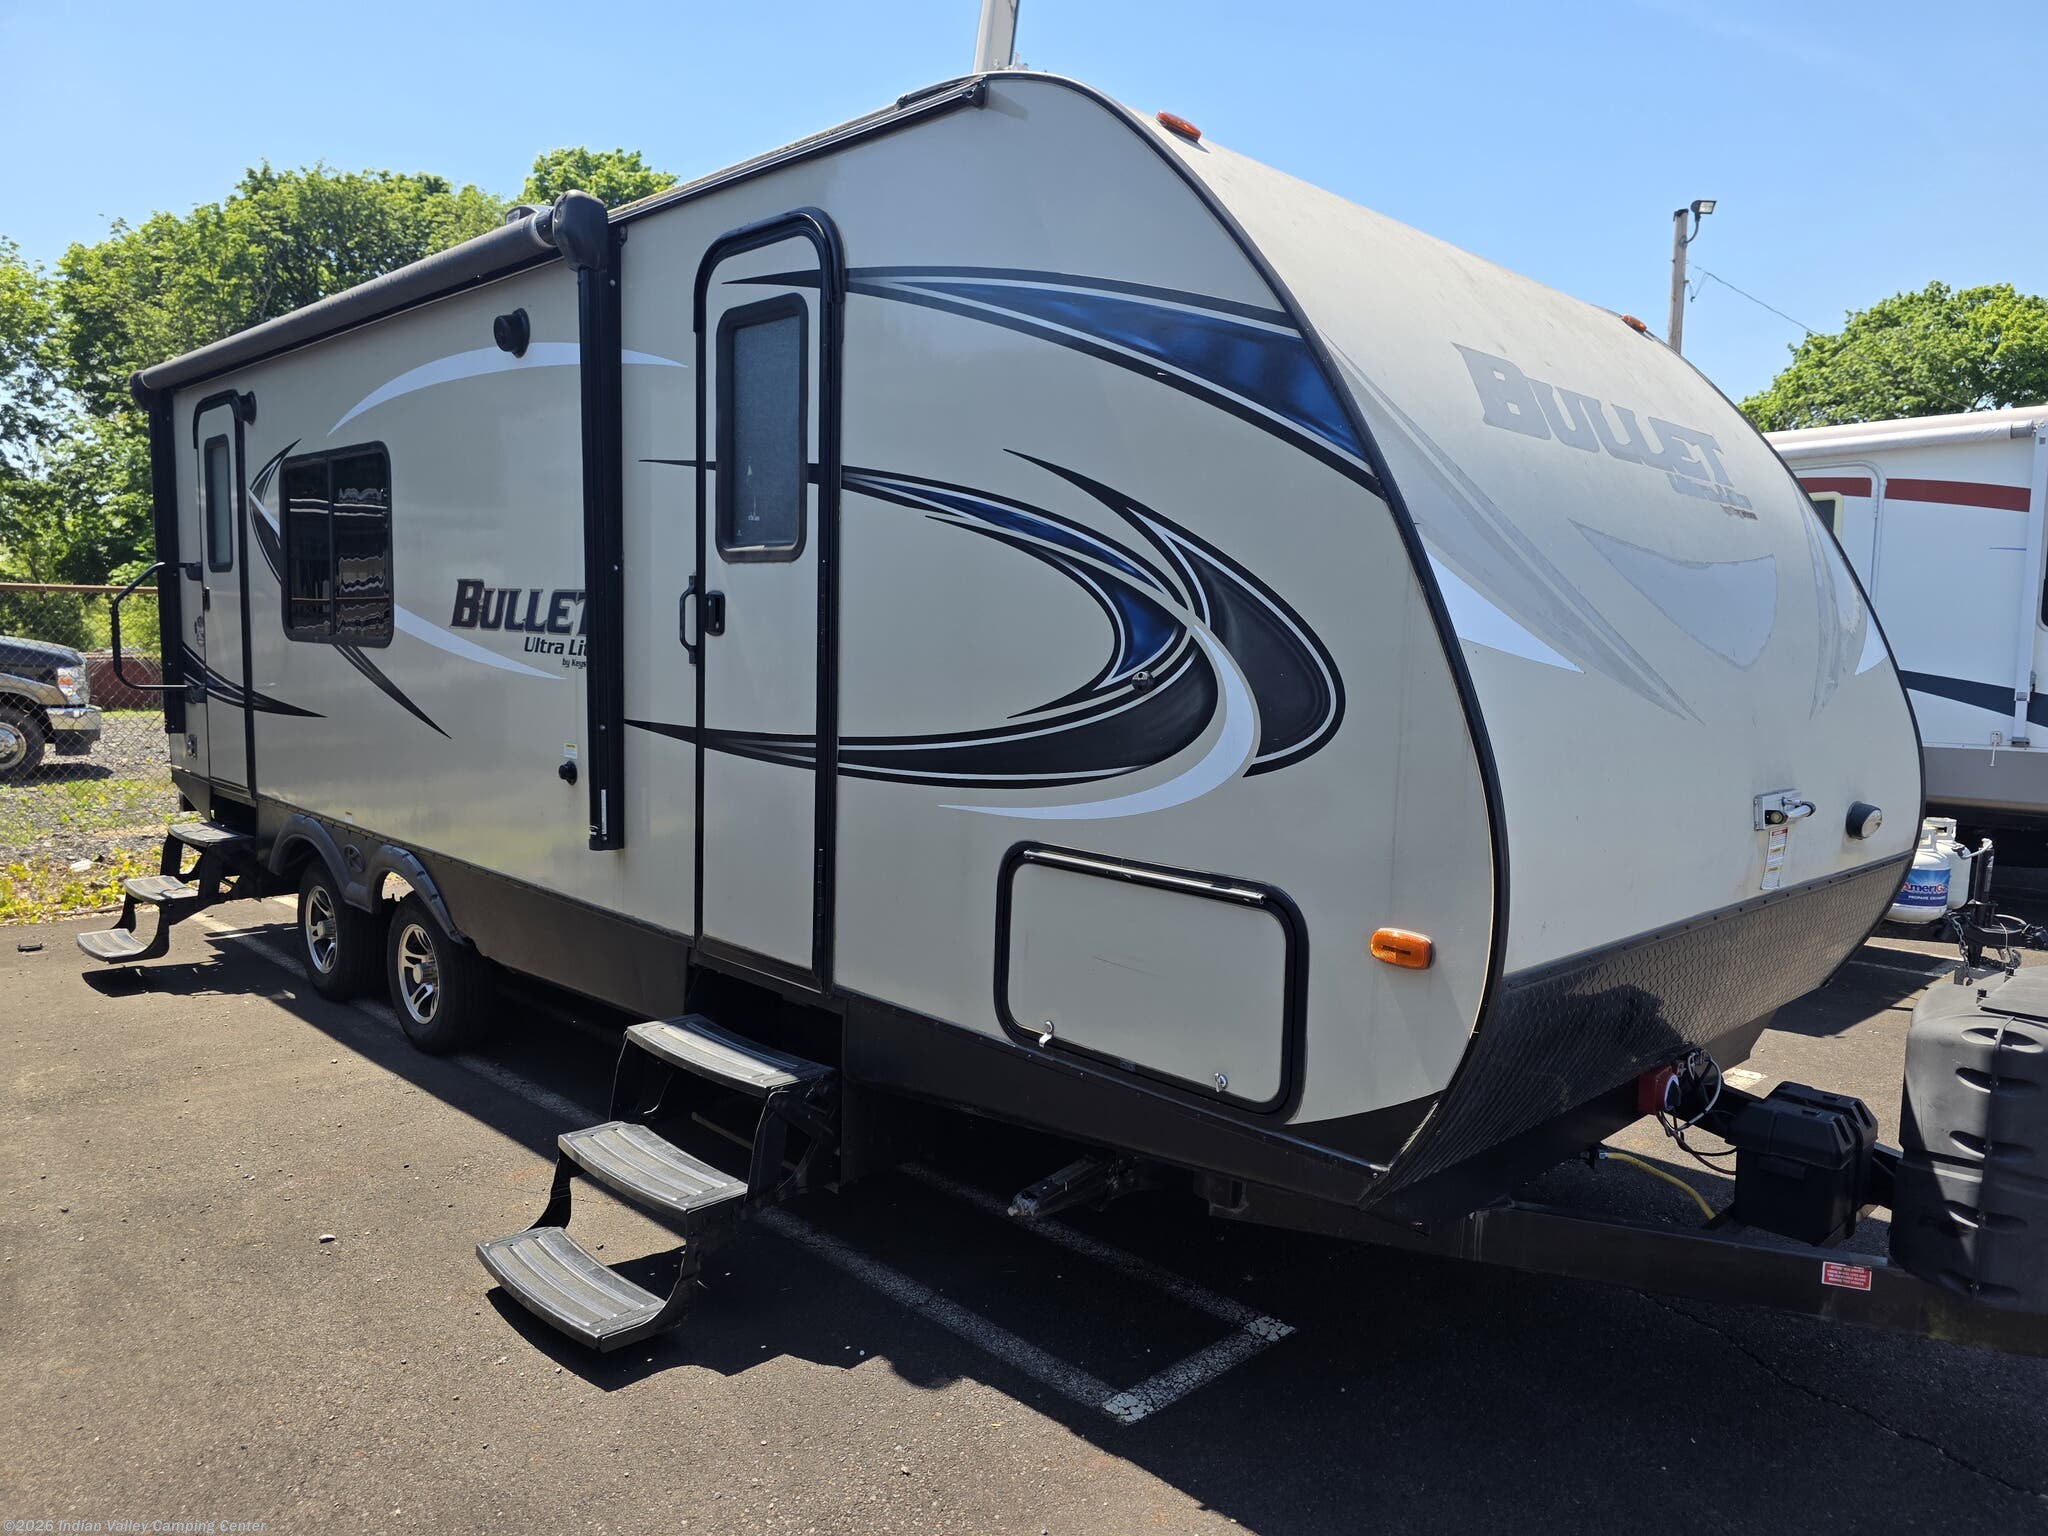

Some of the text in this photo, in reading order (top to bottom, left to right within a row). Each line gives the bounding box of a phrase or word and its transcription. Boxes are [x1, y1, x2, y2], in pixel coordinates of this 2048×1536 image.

[1451, 342, 1734, 489] BULLET
[524, 636, 565, 654] Ultra
[562, 658, 571, 669] by
